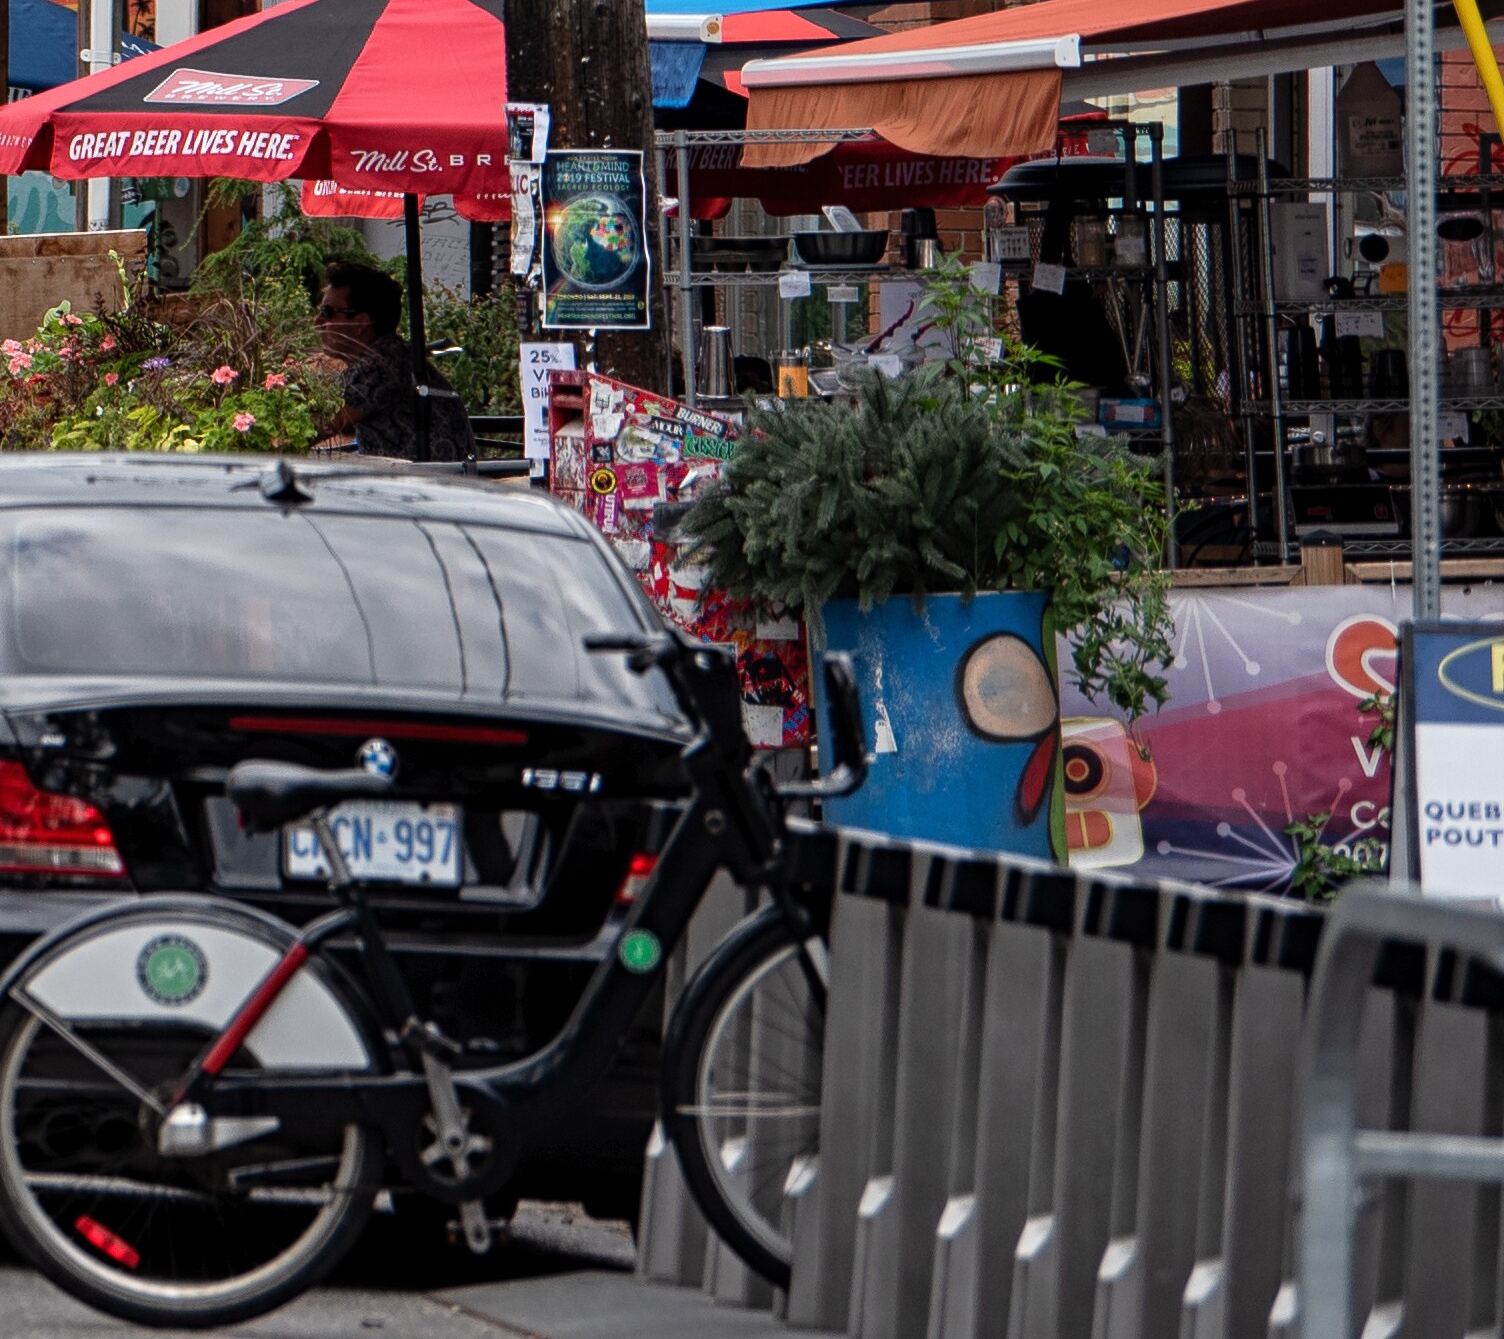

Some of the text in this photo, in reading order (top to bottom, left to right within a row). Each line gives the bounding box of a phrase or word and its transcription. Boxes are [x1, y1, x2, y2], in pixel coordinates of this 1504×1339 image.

[70, 133, 128, 161] GREAT
[129, 130, 180, 157] BEER
[183, 130, 235, 156] LIVES
[350, 150, 405, 173] Mill
[410, 149, 443, 173] St.
[585, 173, 630, 184] FESTIVAL
[838, 163, 880, 190] EER
[885, 161, 934, 187] LIVES
[591, 184, 630, 192] ECOLOGY
[1423, 800, 1501, 820] QUEB
[394, 819, 455, 865] 997
[1425, 828, 1503, 847] POUT
